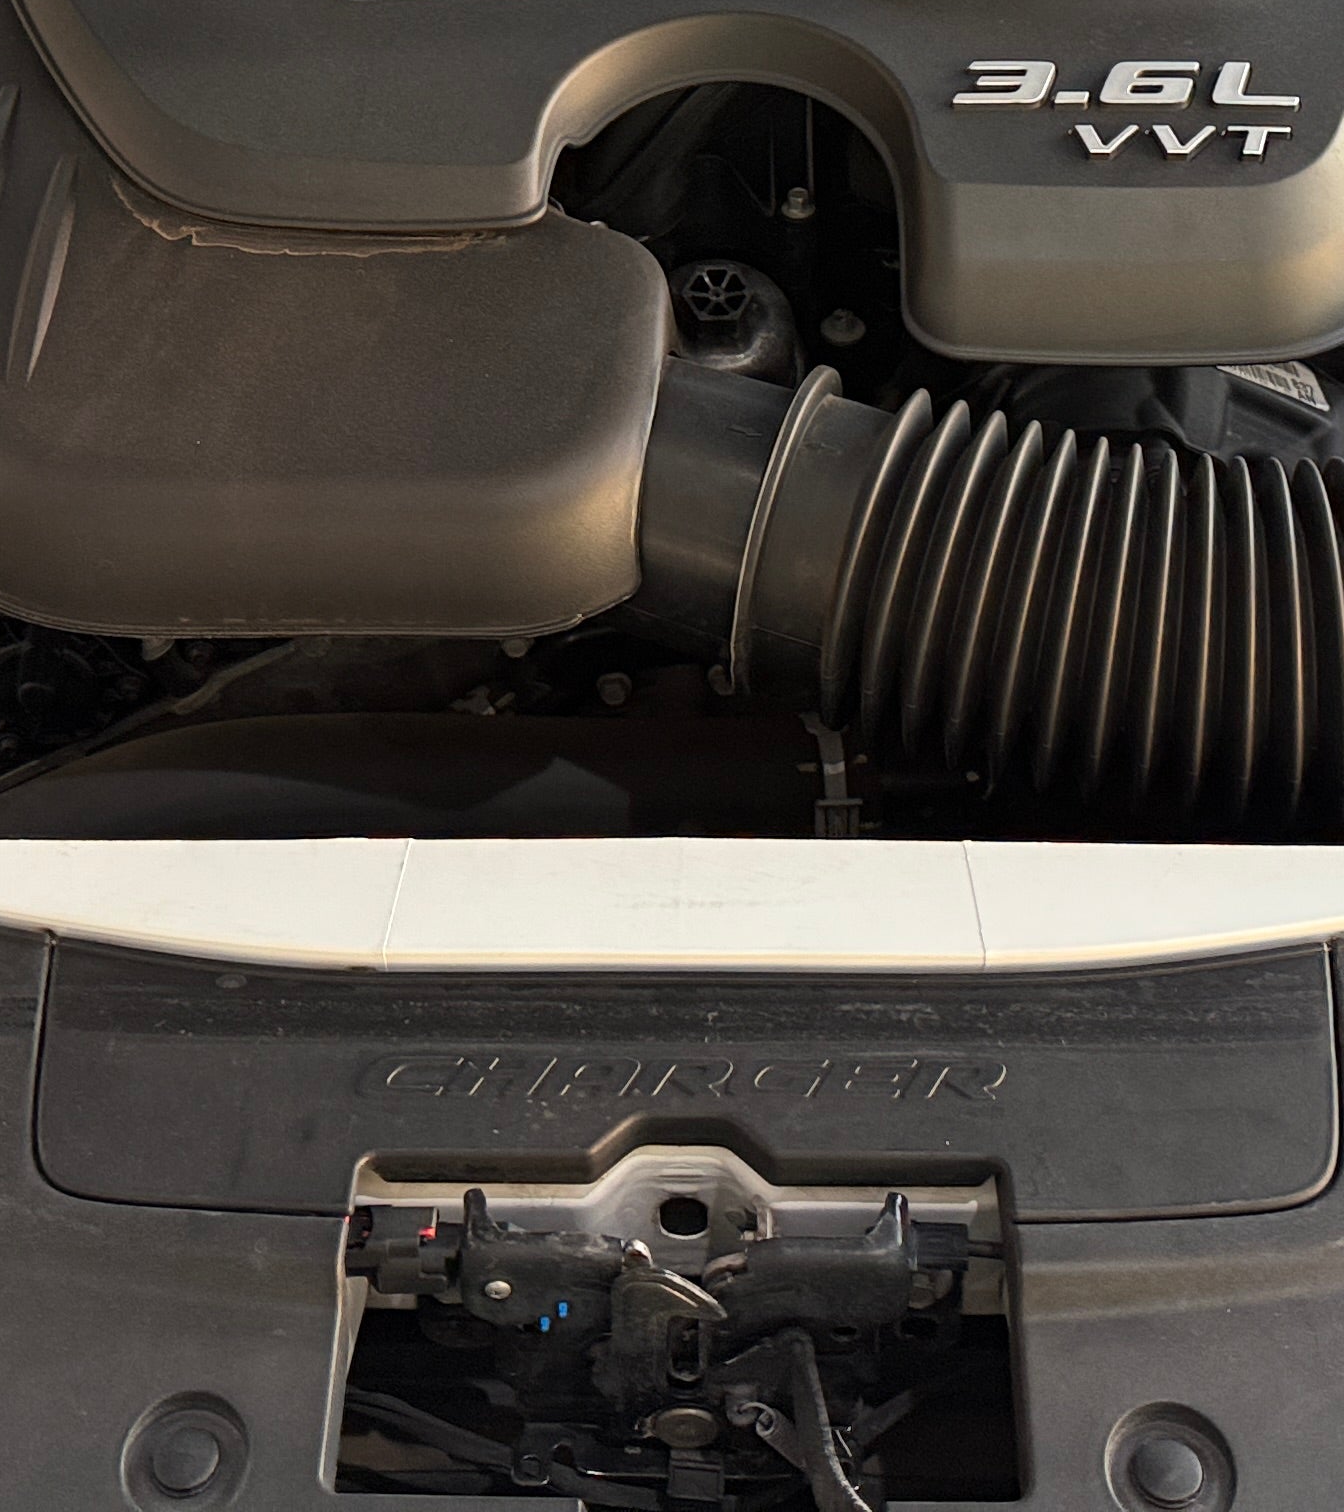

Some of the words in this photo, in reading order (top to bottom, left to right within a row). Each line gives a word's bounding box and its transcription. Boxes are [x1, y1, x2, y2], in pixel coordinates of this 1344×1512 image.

[951, 59, 1301, 110] 3.6L
[1069, 123, 1293, 161] VVT
[355, 1054, 1009, 1101] CHARGER
